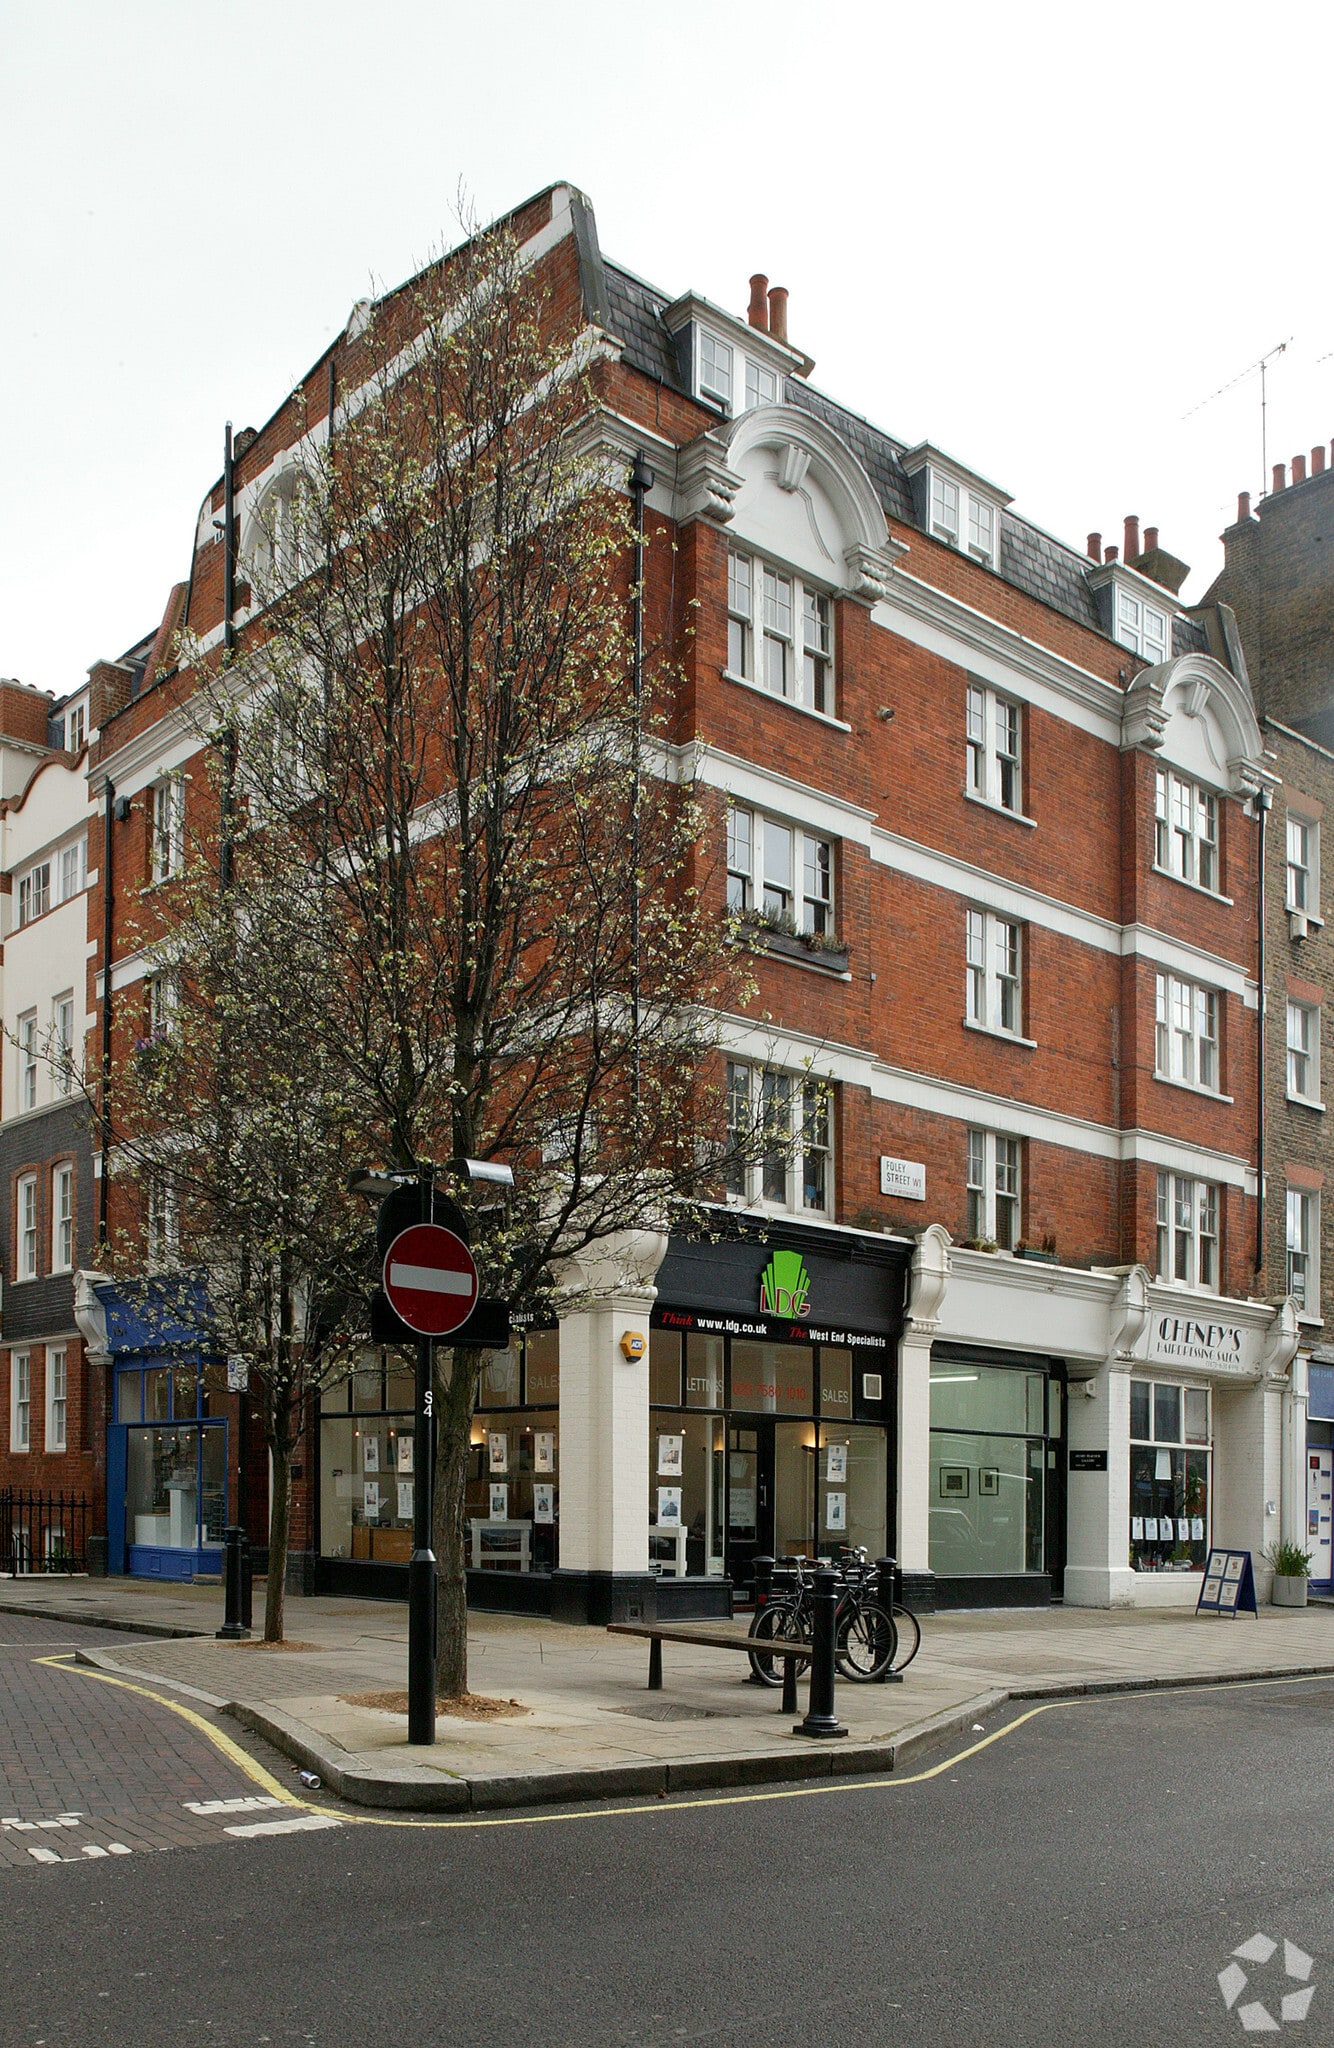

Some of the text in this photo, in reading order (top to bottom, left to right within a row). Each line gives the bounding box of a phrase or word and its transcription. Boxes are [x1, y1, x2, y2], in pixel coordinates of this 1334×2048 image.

[886, 1161, 906, 1173] FOLEY
[886, 1172, 922, 1187] STREET W1
[760, 1284, 811, 1317] LDG
[661, 1312, 767, 1334] Think www.ldg.co.uk
[789, 1326, 886, 1347] The West End Specialists
[1159, 1317, 1242, 1351] CHENEY'S
[1157, 1342, 1240, 1363] HAIRDRESSING SALON
[529, 1374, 559, 1390] SALE
[423, 1390, 433, 1418] S 4
[822, 1388, 849, 1404] SALES
